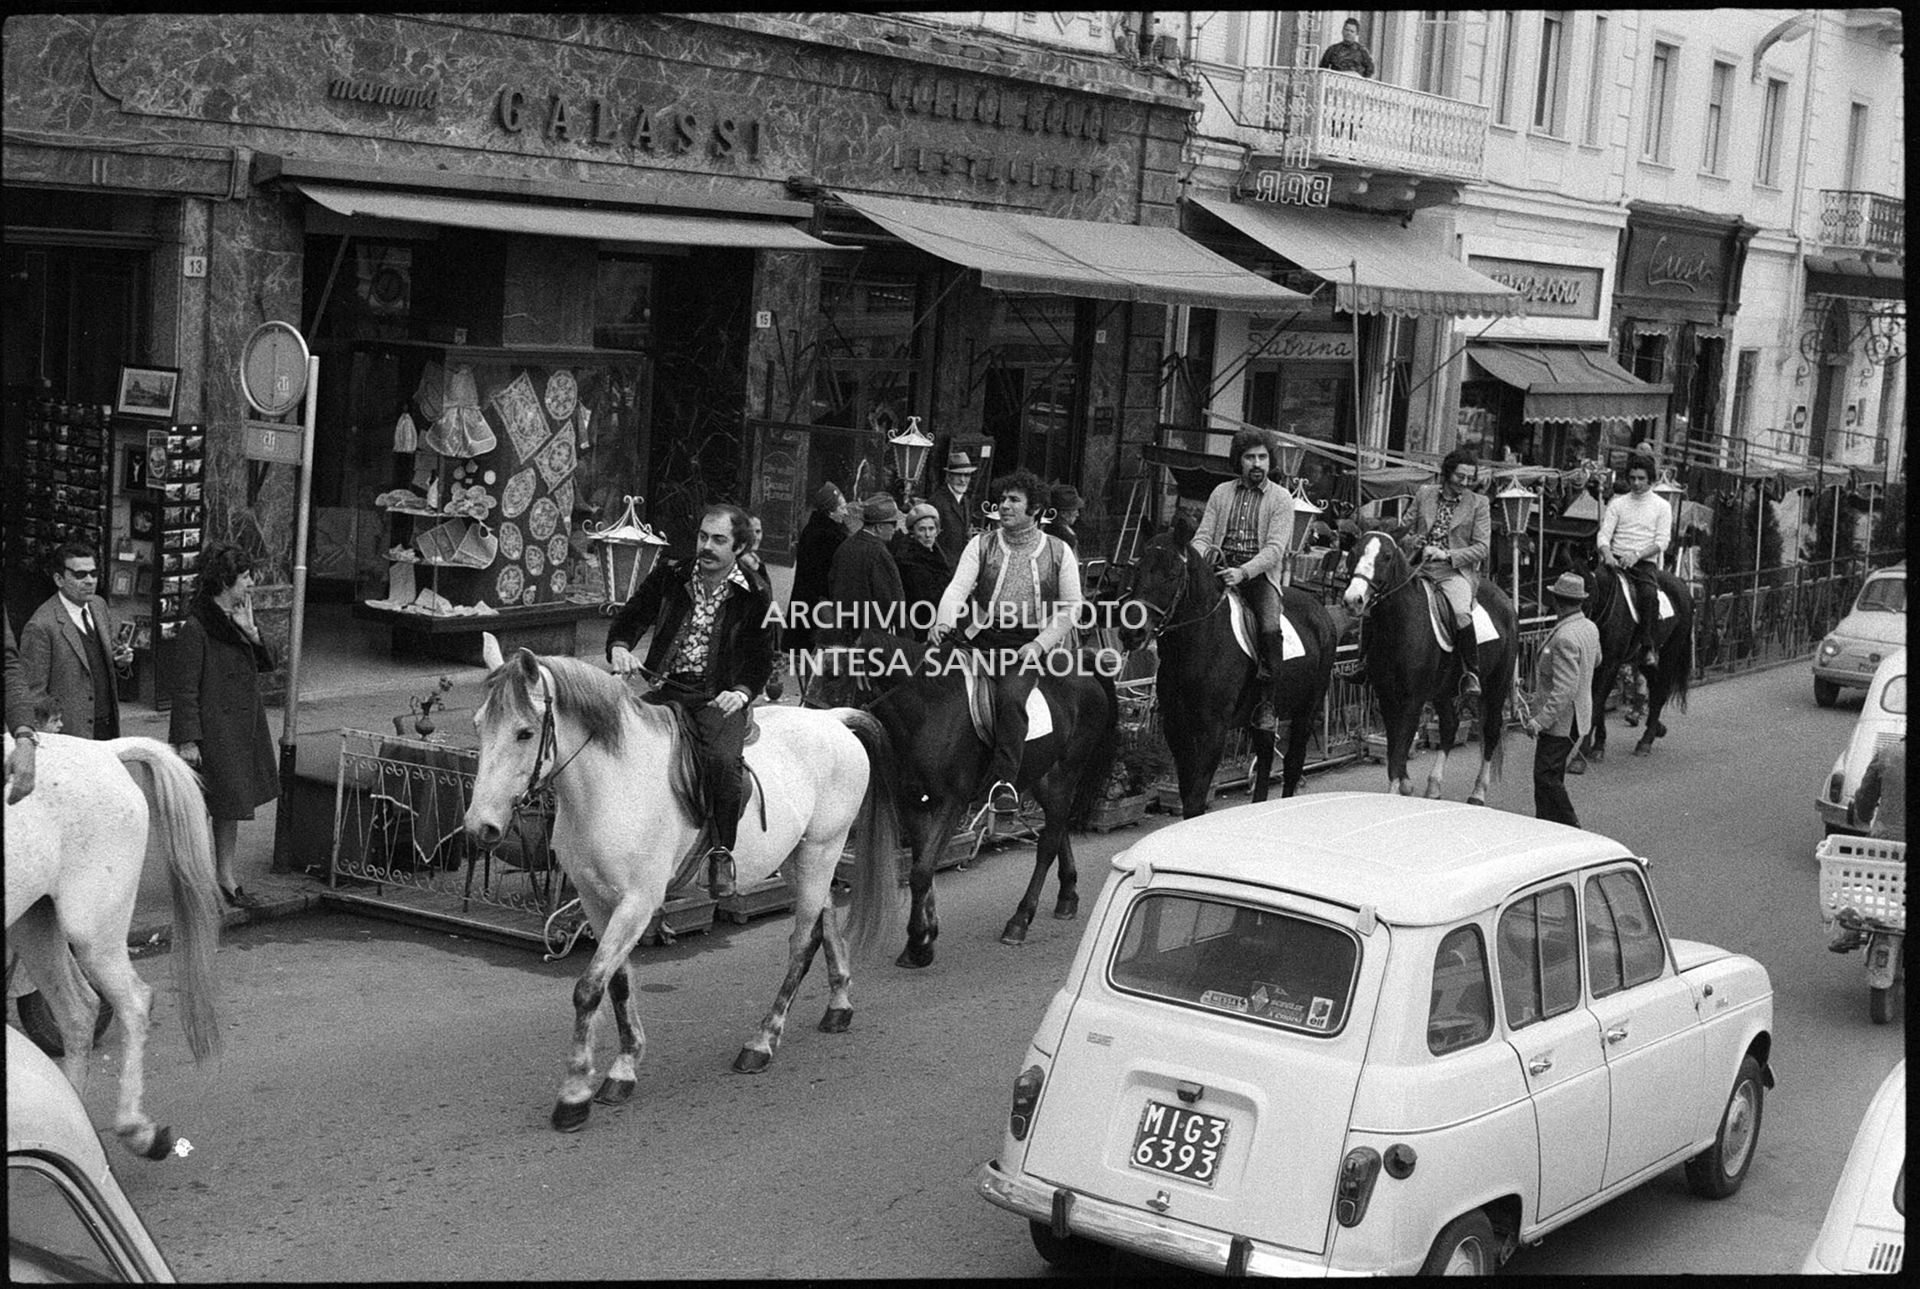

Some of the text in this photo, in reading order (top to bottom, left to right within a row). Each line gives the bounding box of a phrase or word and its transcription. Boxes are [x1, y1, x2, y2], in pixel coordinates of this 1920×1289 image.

[498, 90, 760, 162] GALASSI
[190, 259, 203, 274] 13
[1247, 331, 1352, 357] Sabrina
[1309, 1016, 1327, 1027] elf
[1136, 1136, 1218, 1179] 6393
